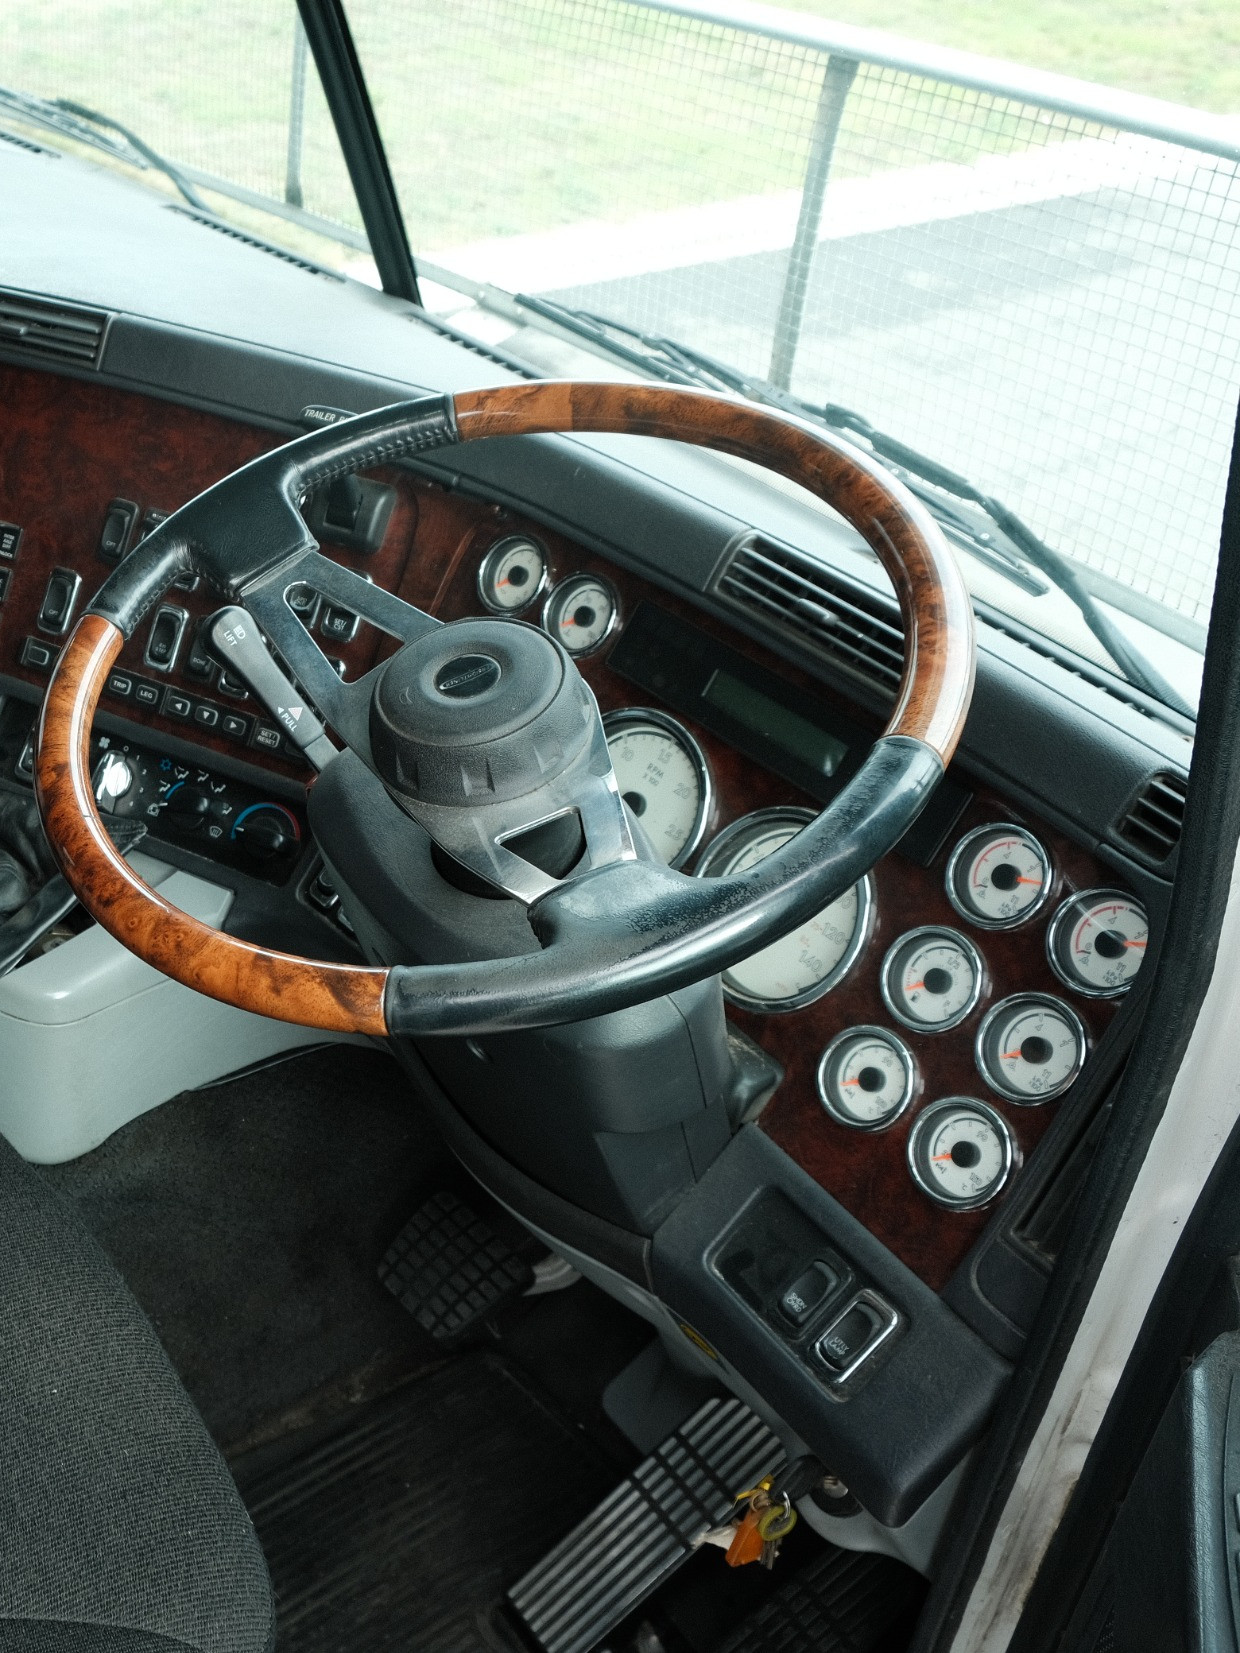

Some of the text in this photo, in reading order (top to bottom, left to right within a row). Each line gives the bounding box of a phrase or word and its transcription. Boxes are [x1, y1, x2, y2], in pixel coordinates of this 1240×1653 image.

[304, 409, 336, 422] TRAILER
[223, 630, 238, 646] LIFT
[113, 680, 127, 689] TRIP
[140, 690, 153, 699] LEG
[281, 712, 298, 732] PULL
[257, 735, 276, 746] RESET
[621, 746, 635, 762] 10
[647, 762, 665, 778] RPM
[673, 782, 693, 800] 20
[664, 823, 684, 840] 25
[822, 922, 846, 945] 120
[799, 949, 823, 972] 140
[1106, 969, 1118, 981] kPa
[786, 1297, 802, 1313] OVRD
[828, 1340, 846, 1355] LAMP
[834, 1336, 850, 1351] UTLY
